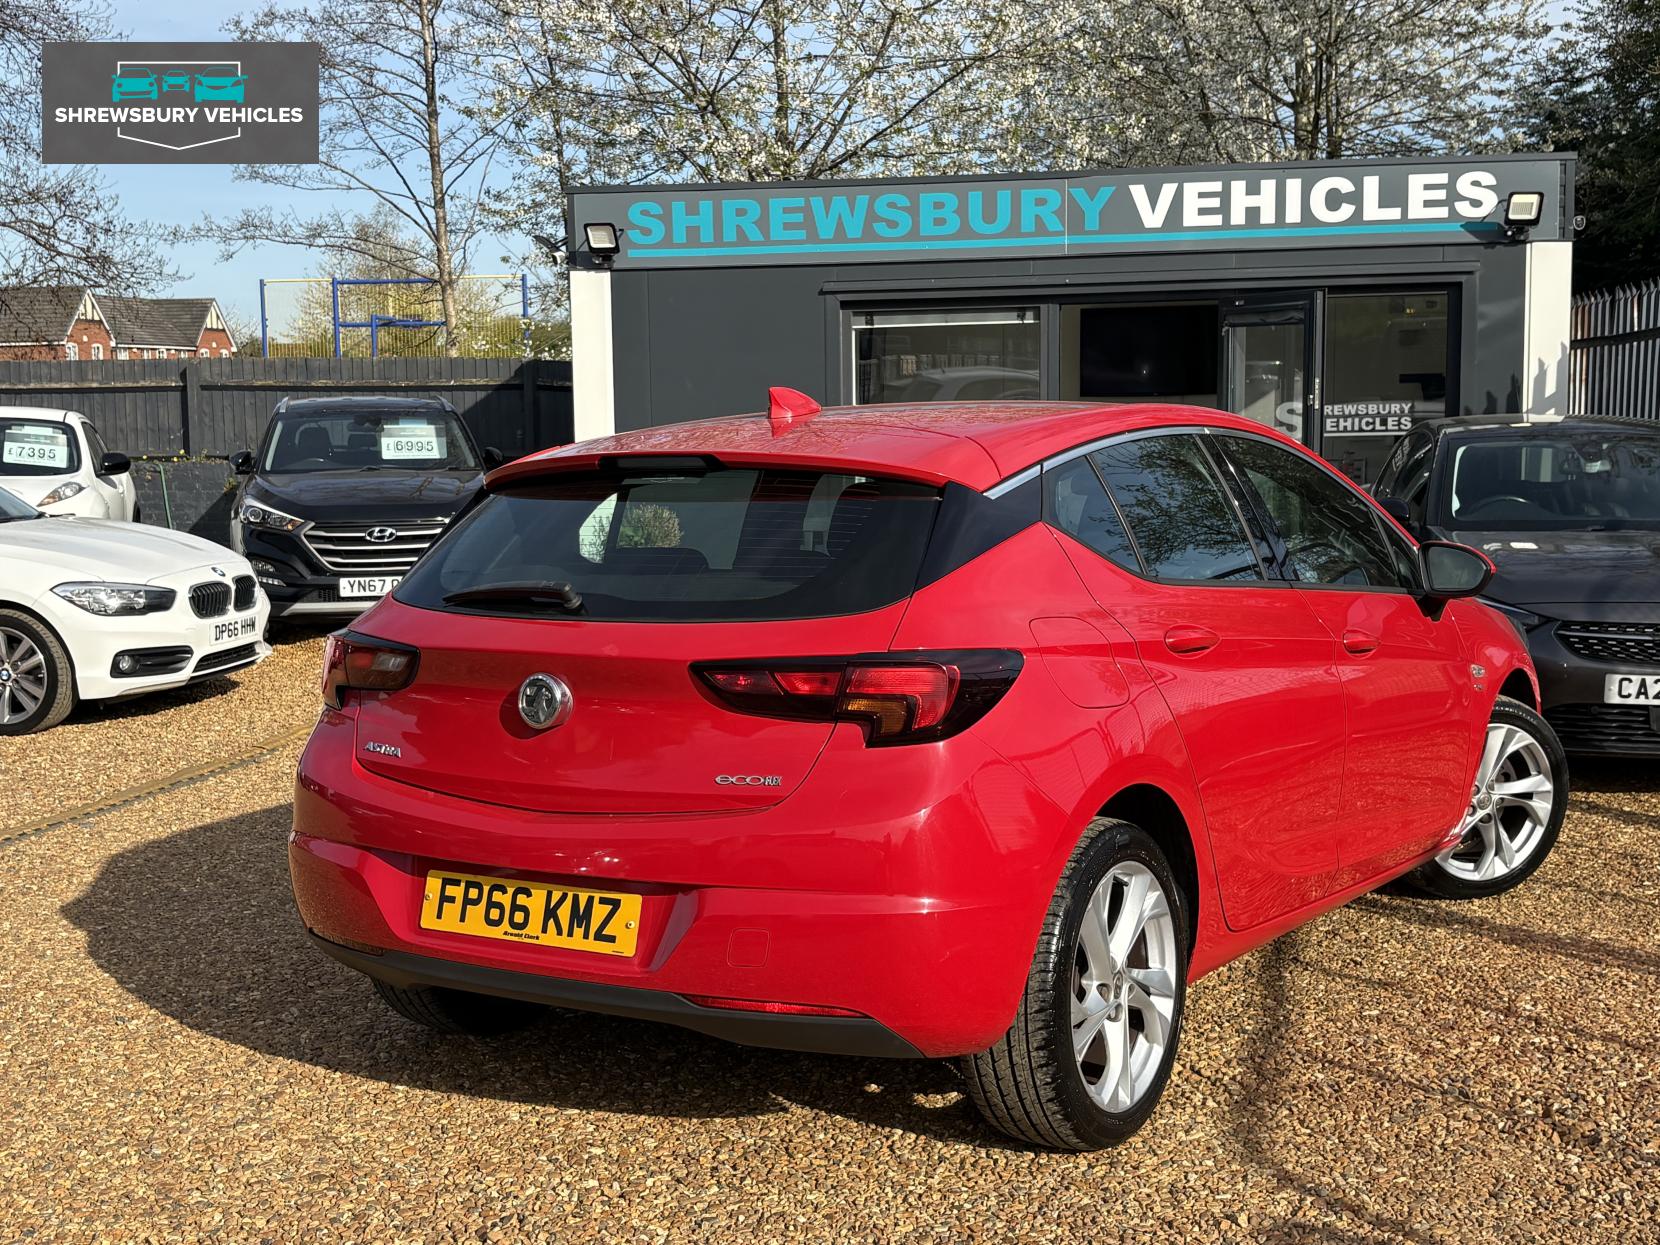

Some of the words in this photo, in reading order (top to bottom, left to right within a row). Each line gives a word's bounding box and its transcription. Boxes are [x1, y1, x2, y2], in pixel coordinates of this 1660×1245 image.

[627, 186, 1117, 245] SHREWSBURY
[1128, 171, 1499, 229] VEHICLES
[347, 579, 386, 593] YN67
[214, 621, 239, 641] DP66
[365, 741, 402, 758] ASTRA
[436, 877, 533, 931] FP66
[541, 889, 622, 944] KMZ
